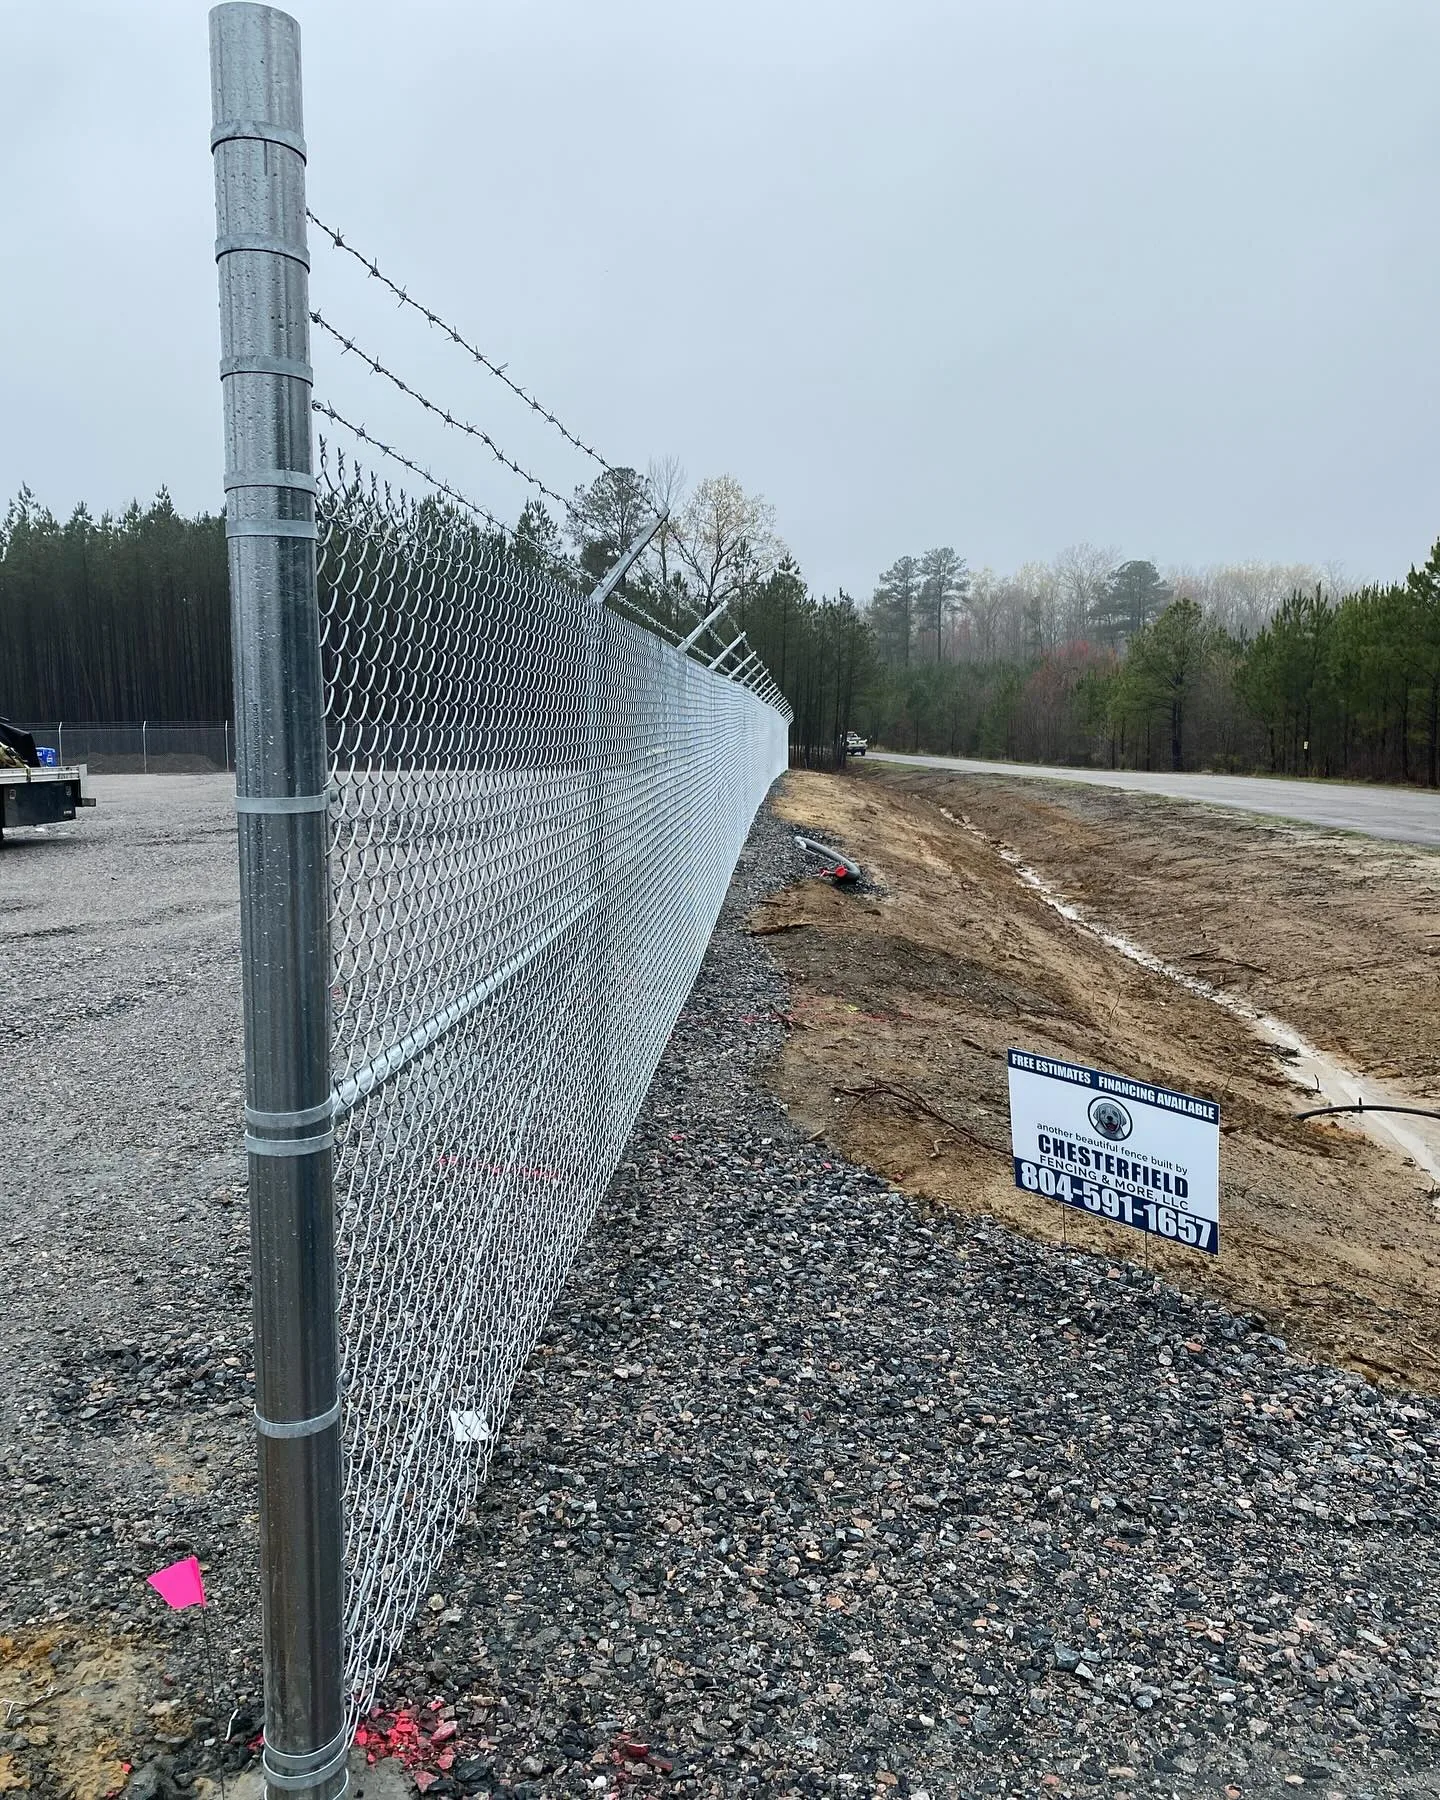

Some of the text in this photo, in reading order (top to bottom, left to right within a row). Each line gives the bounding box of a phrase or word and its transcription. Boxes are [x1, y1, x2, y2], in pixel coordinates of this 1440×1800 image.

[1012, 1053, 1214, 1120] FREE ESTIMATES FINANCING AVAILABLE
[1037, 1123, 1188, 1176] another beautiful fence built by
[1038, 1134, 1189, 1198] CHESTERFIELD
[1021, 1162, 1212, 1248] 804-591-1657
[1040, 1155, 1189, 1211] FENCING & MORE, LLC
